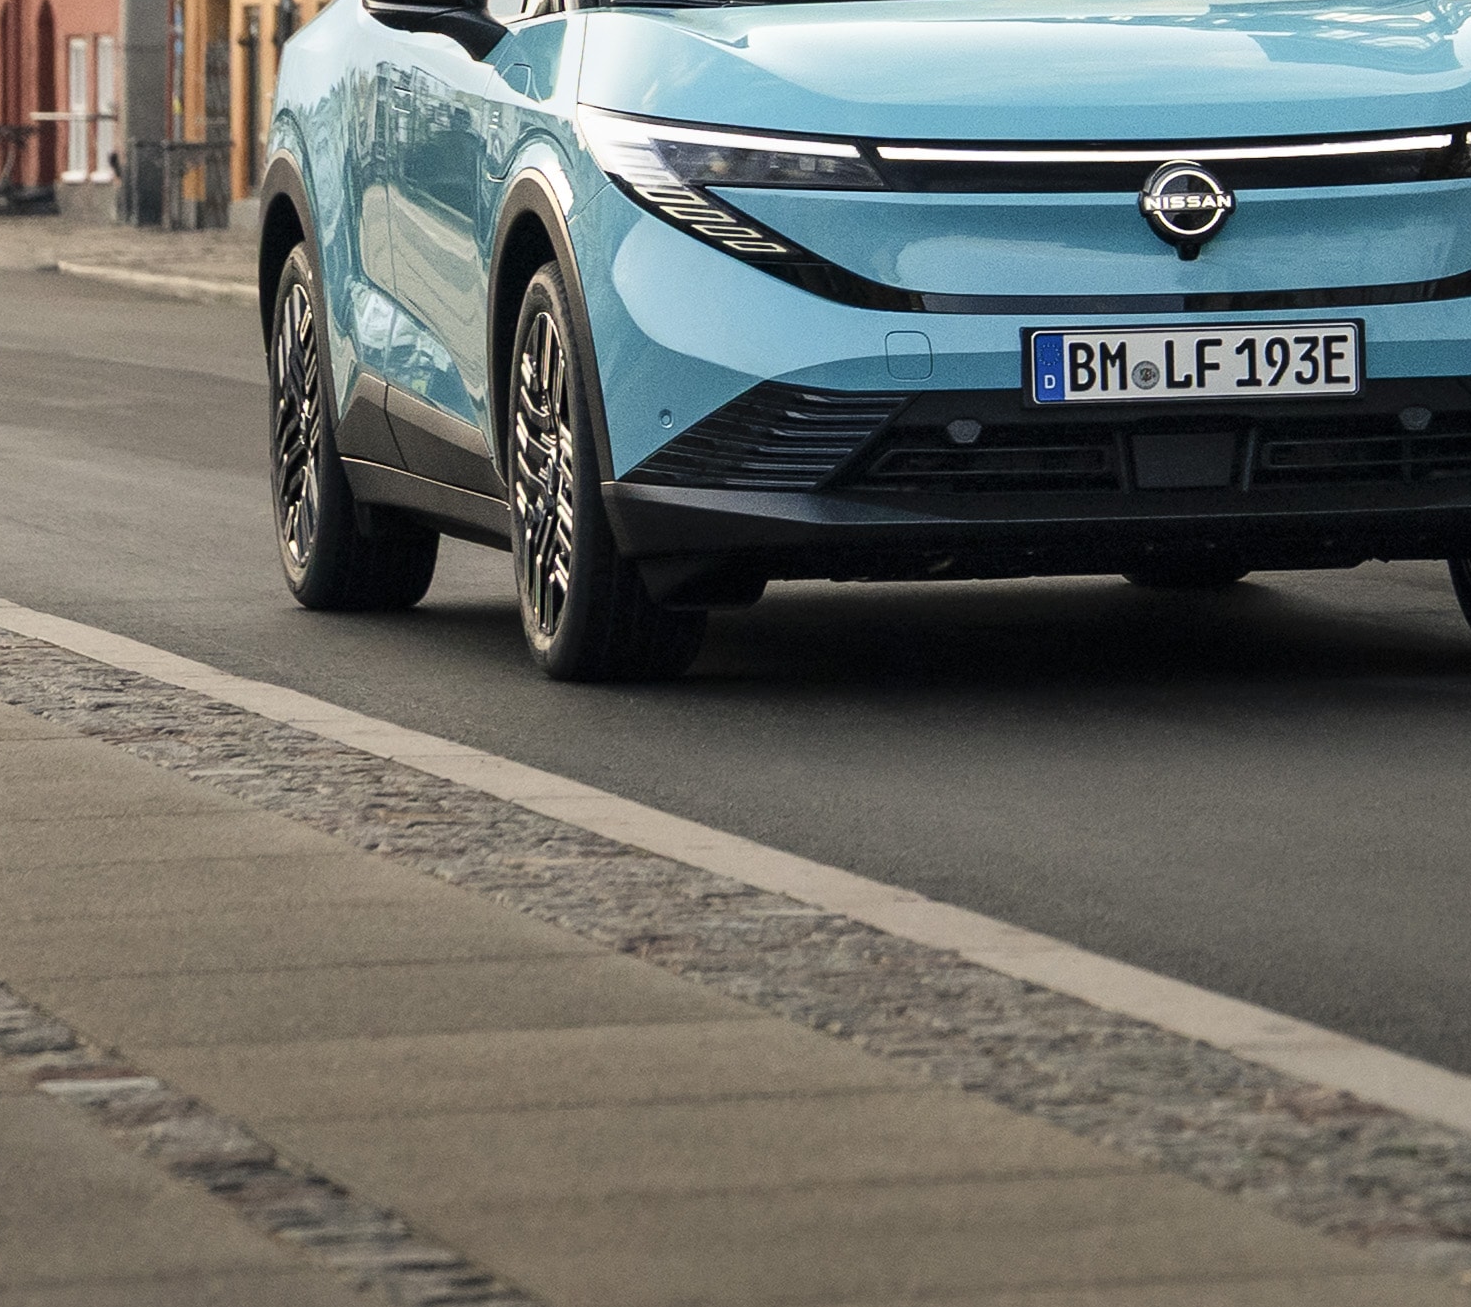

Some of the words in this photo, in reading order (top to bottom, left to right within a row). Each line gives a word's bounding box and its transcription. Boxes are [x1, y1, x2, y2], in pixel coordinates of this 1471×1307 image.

[1144, 194, 1232, 211] NISSAN
[1068, 341, 1128, 392] BM
[1164, 338, 1223, 390] LF
[1234, 334, 1351, 388] 193E
[1044, 375, 1056, 389] D
